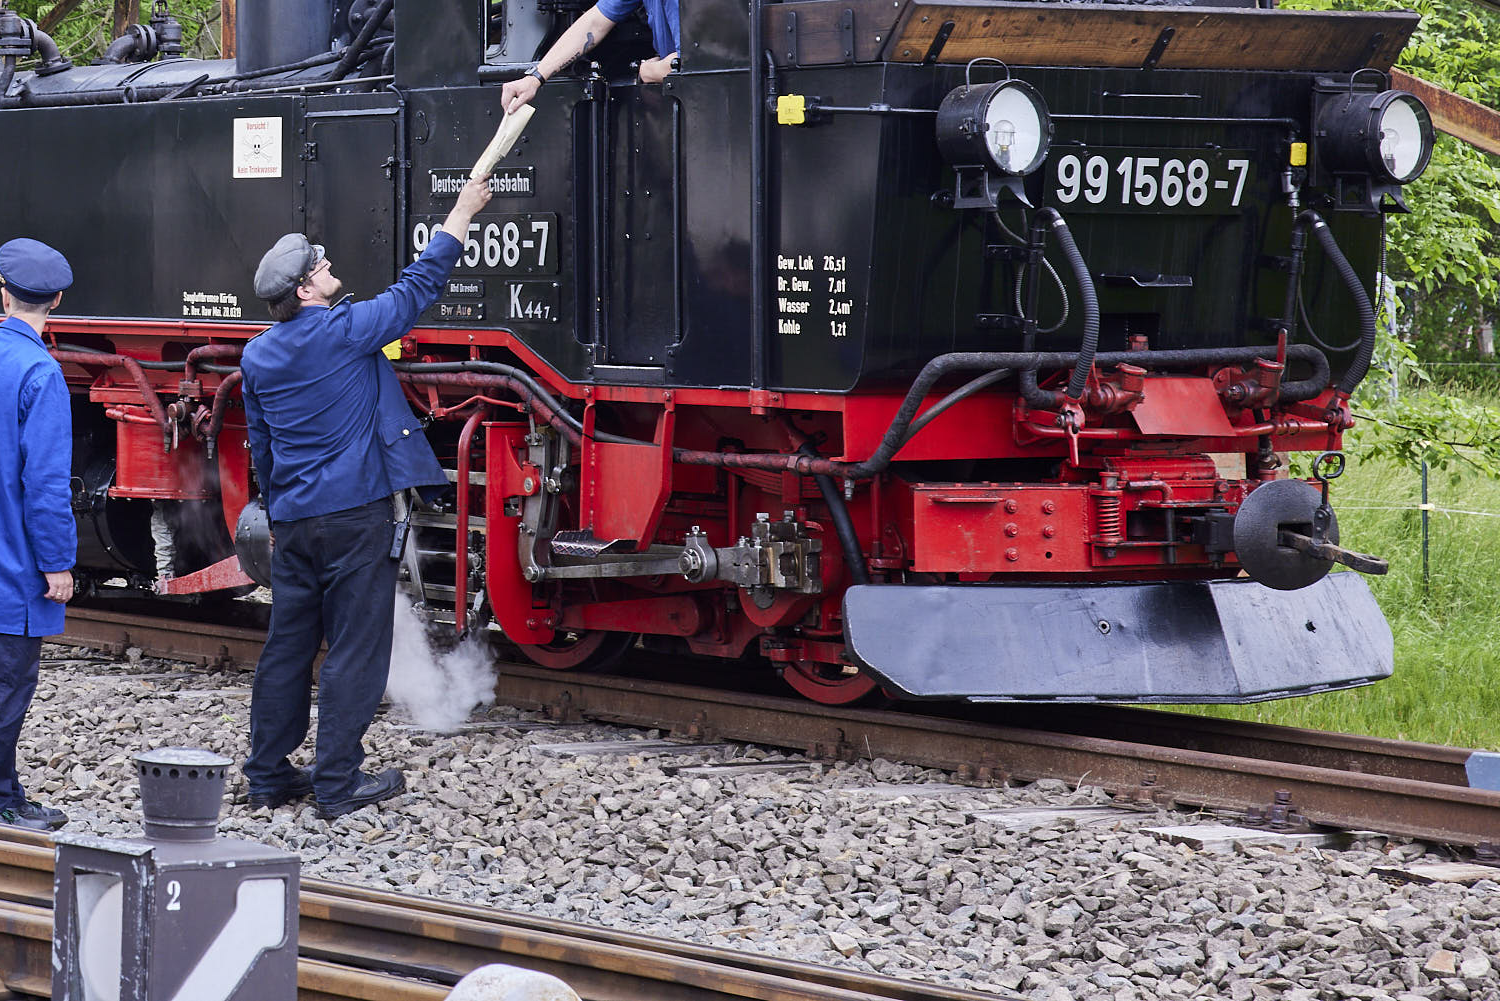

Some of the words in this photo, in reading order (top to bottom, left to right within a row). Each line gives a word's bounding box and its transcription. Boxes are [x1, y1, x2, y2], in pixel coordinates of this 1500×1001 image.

[246, 122, 265, 130] Vorsicht
[237, 166, 248, 174] Kein
[249, 165, 277, 174] Trinkwasser
[431, 174, 472, 193] Deutsch
[1056, 155, 1109, 204] 99
[1116, 157, 1249, 207] 1568-7
[777, 255, 797, 270] Gew.
[798, 255, 814, 271] Lok
[823, 256, 846, 272] 26,5t
[460, 283, 479, 293] Dresden
[777, 276, 790, 291] Br.
[792, 276, 812, 292] Gew.
[828, 277, 846, 294] 7,0t
[440, 304, 454, 316] Bw
[456, 304, 472, 316] Aue
[778, 297, 811, 314] Wasser
[778, 318, 801, 335] Kohle
[830, 320, 847, 338] 1,2t
[166, 880, 181, 911] 2
